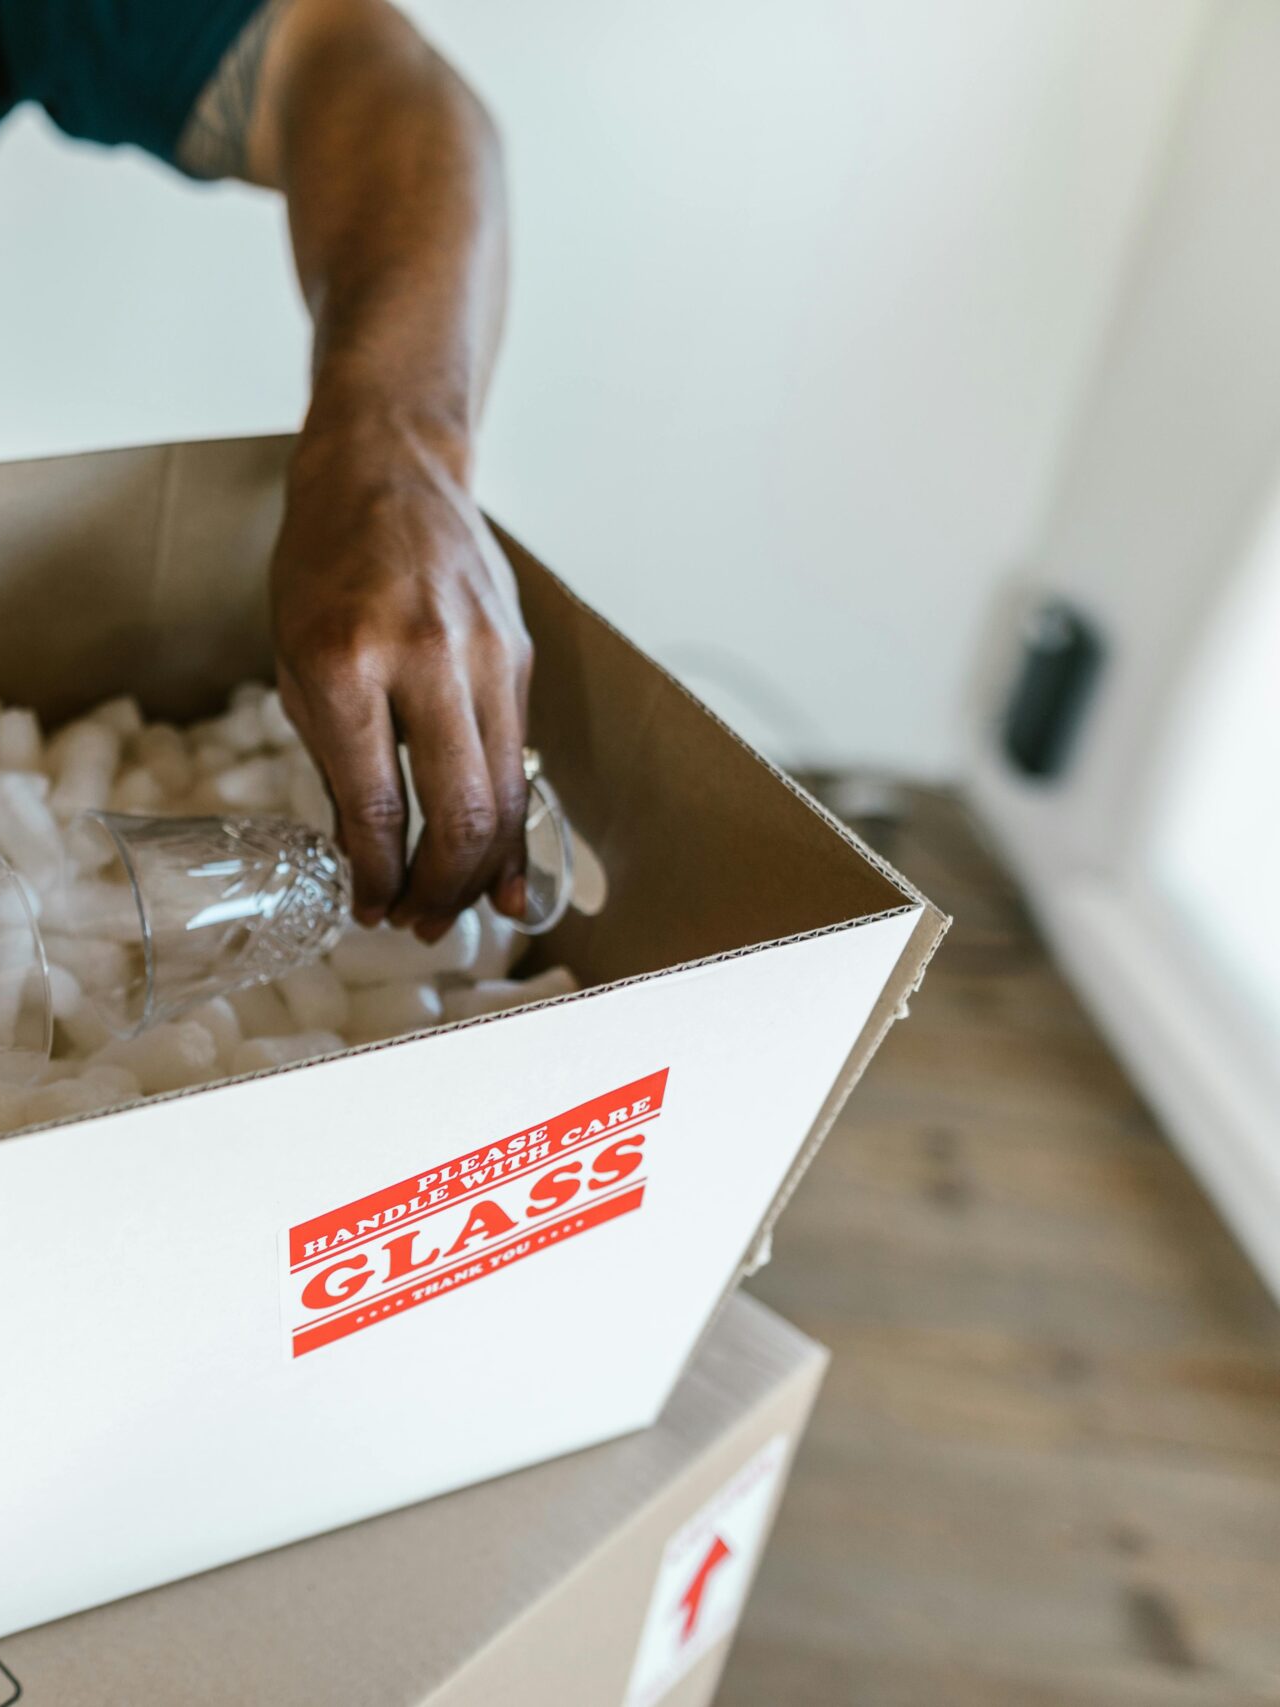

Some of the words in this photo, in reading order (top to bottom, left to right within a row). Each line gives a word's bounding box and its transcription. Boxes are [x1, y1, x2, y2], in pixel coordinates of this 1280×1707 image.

[303, 1184, 449, 1257] HANDLE
[462, 1140, 551, 1191] WITH
[560, 1095, 652, 1147] CARE
[417, 1124, 549, 1193] PLEASE
[301, 1133, 646, 1310] GLASS
[411, 1263, 484, 1302] THANK
[489, 1240, 531, 1269] YOU
